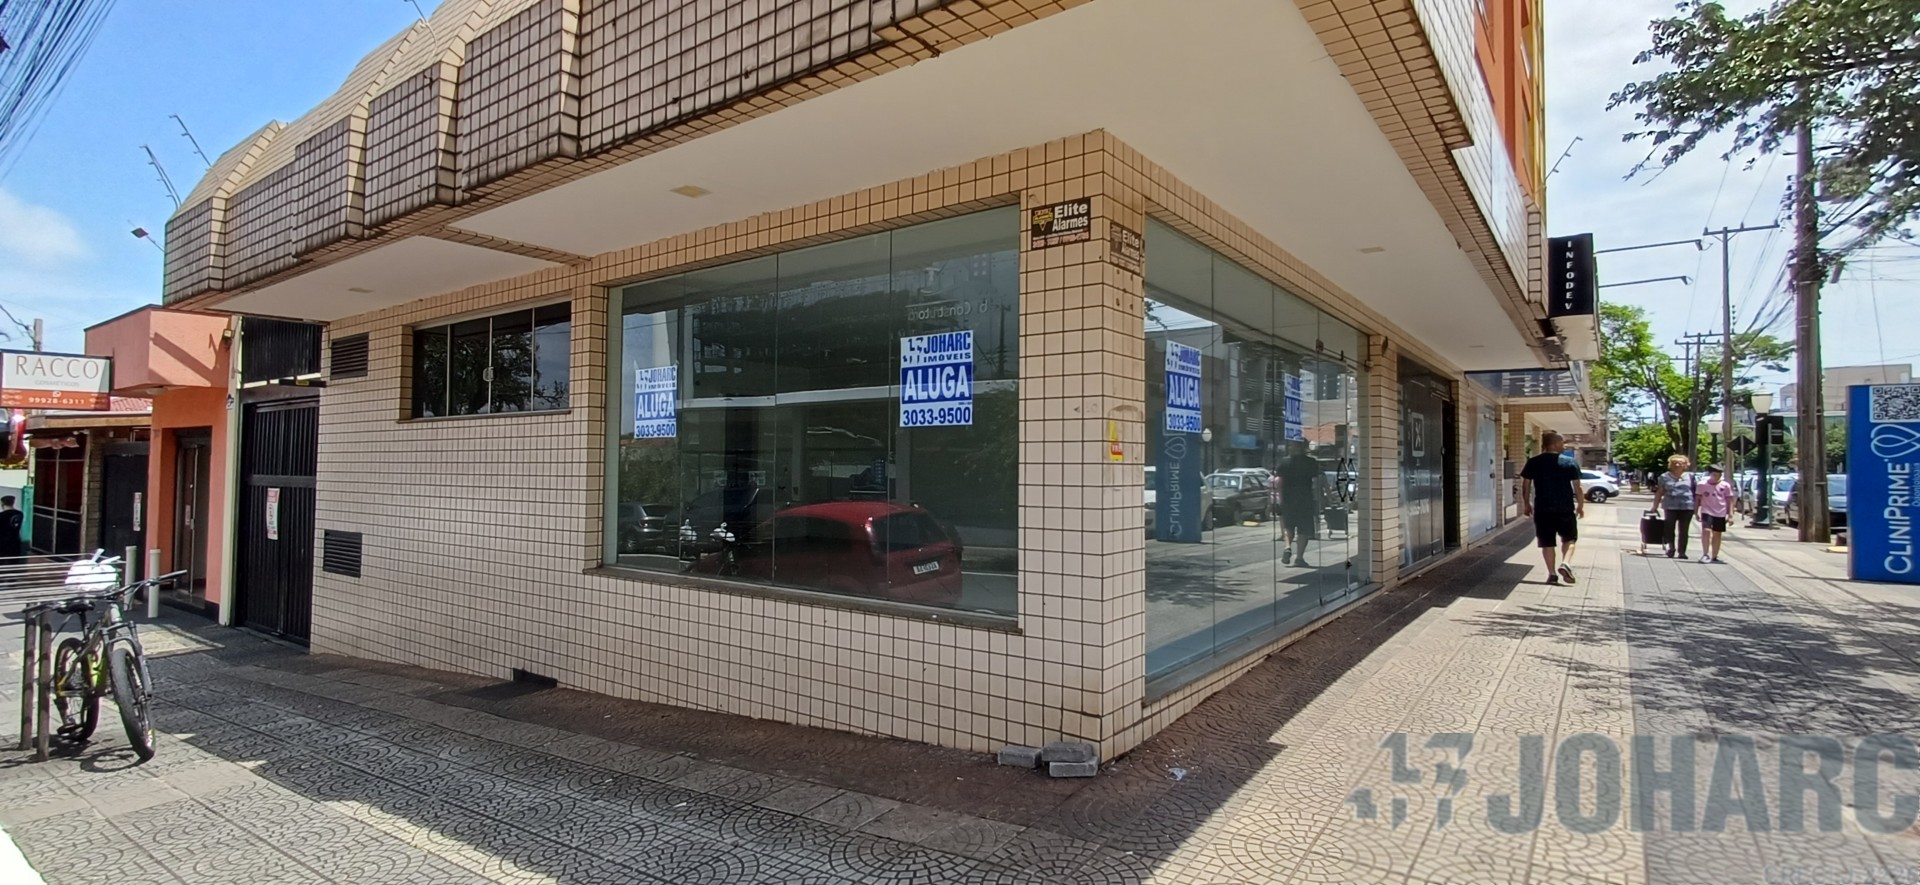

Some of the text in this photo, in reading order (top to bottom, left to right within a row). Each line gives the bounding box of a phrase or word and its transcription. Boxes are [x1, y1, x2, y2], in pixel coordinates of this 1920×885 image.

[1054, 203, 1088, 219] Elite
[1052, 216, 1088, 232] Alarmes
[1565, 241, 1575, 310] INFODEV
[924, 331, 971, 354] JOHARC
[16, 355, 99, 379] RACCO
[648, 367, 676, 383] JOHARC
[904, 365, 970, 401] ALUGA
[1168, 374, 1200, 408] ALUGA
[28, 397, 85, 405] 99928-6311
[637, 392, 675, 418] ALUGA
[903, 407, 971, 425] 3033-9500
[1168, 413, 1200, 431] 3033-9500
[635, 423, 676, 437] 3033-9500
